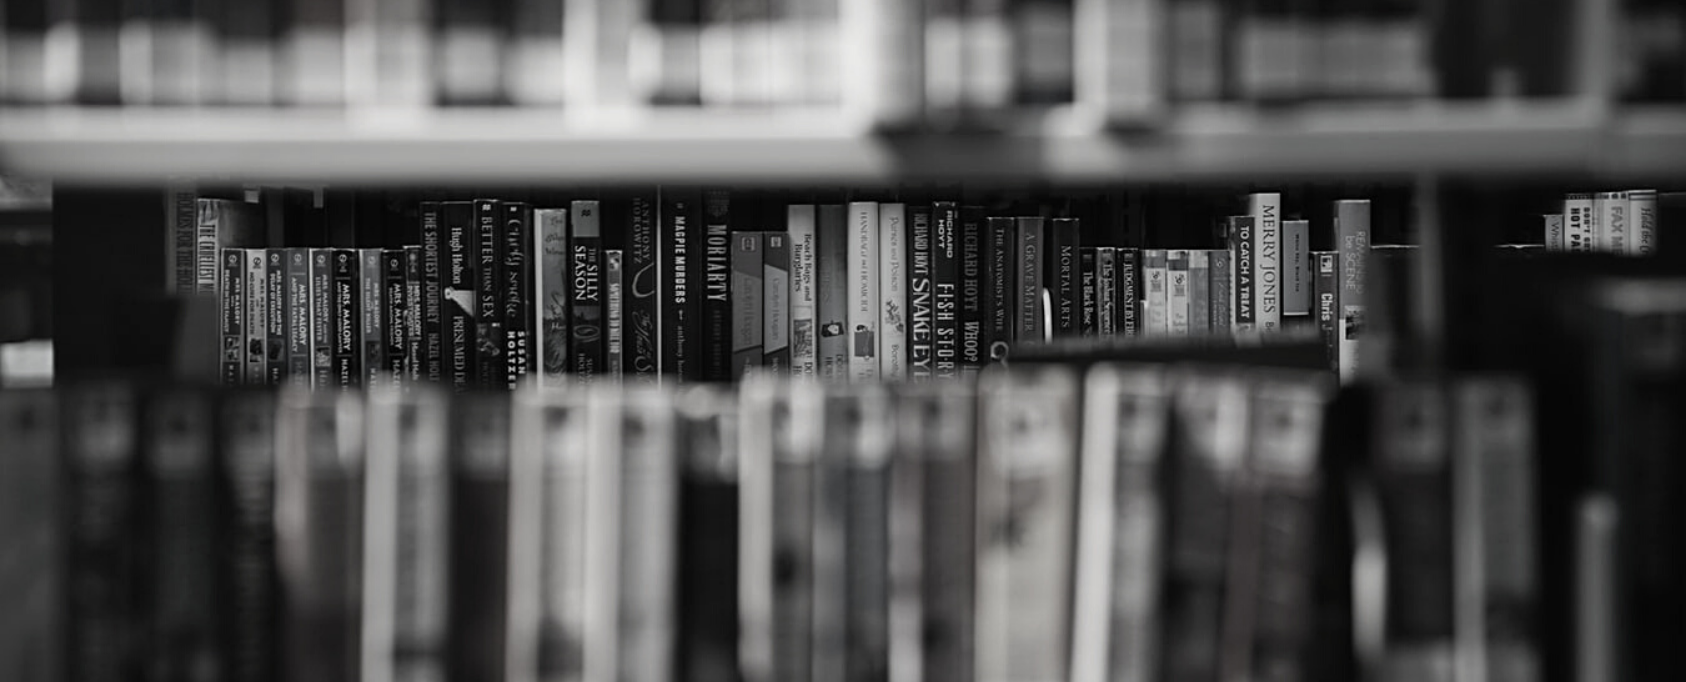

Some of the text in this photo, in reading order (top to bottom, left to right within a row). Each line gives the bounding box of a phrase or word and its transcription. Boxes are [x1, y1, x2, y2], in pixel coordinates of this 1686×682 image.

[176, 231, 193, 247] FOR
[199, 225, 215, 238] THE
[424, 212, 436, 229] THE
[449, 227, 464, 251] Hugh
[633, 198, 641, 264] HOROWITZ
[642, 201, 650, 260] ANTHONY
[674, 216, 686, 254] MAGPIE
[913, 213, 928, 250] RICHARD
[995, 228, 1005, 246] THE
[1263, 205, 1275, 261] MERRY
[1571, 208, 1580, 229] HOT
[1611, 206, 1623, 232] FAX
[176, 251, 193, 266] THE
[425, 231, 438, 278] SHORTEST
[452, 254, 465, 284] Holton
[481, 216, 494, 318] BETTER THAN SEX
[574, 245, 586, 301] SEASON
[587, 248, 598, 302] THE SILLY
[707, 224, 727, 302] MORIARTY
[793, 244, 802, 292] Burglaries
[803, 234, 812, 301] Beach Bags and
[914, 252, 928, 275] HOYT
[1083, 271, 1093, 285] The
[1240, 225, 1250, 319] TO CATCH A TREAT
[1345, 236, 1356, 290] be SCENE
[426, 281, 439, 323] JOURNEY
[674, 256, 686, 303] MURDERS
[963, 222, 980, 362] RICHARD HOYT WHOO?
[1024, 233, 1035, 332] A GRAVE MATTER
[1061, 245, 1071, 328] MORTAL ARTS
[1123, 263, 1134, 309] JUDGMENT
[1260, 265, 1275, 313] JONES
[912, 278, 930, 341] SNAKE
[1321, 293, 1333, 321] Chris
[428, 333, 439, 358] HAZEL
[453, 316, 465, 370] PRESUMED
[507, 331, 516, 390] HOLTZER
[517, 331, 525, 375] SUSAN
